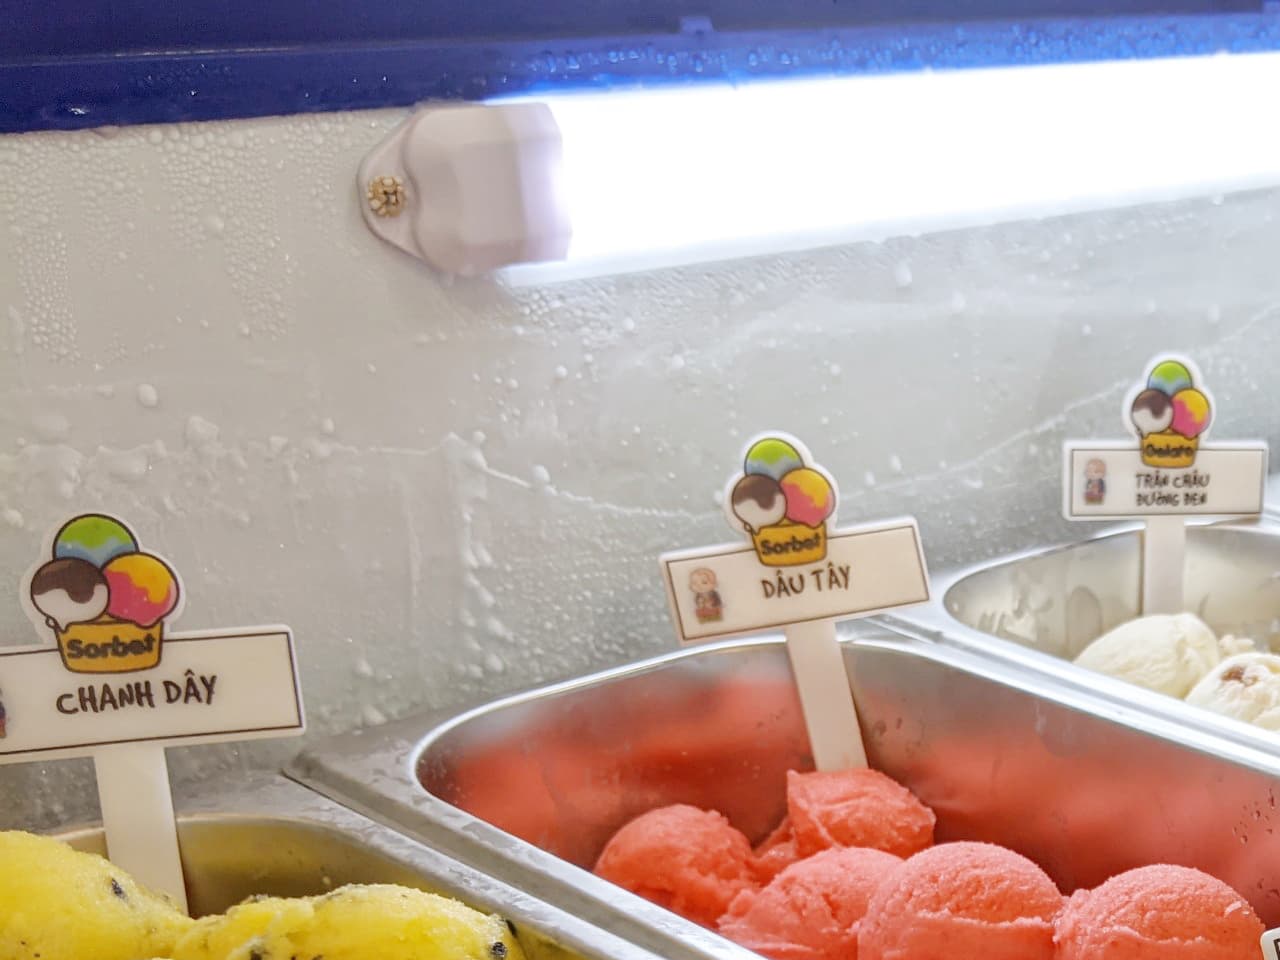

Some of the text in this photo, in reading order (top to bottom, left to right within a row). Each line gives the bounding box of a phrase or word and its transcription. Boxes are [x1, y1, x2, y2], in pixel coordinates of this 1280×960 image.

[761, 532, 821, 556] Sorbet
[761, 561, 851, 599] DÂU TÂY
[66, 632, 156, 660] Sorbet
[55, 668, 217, 715] CHANH DÂY
